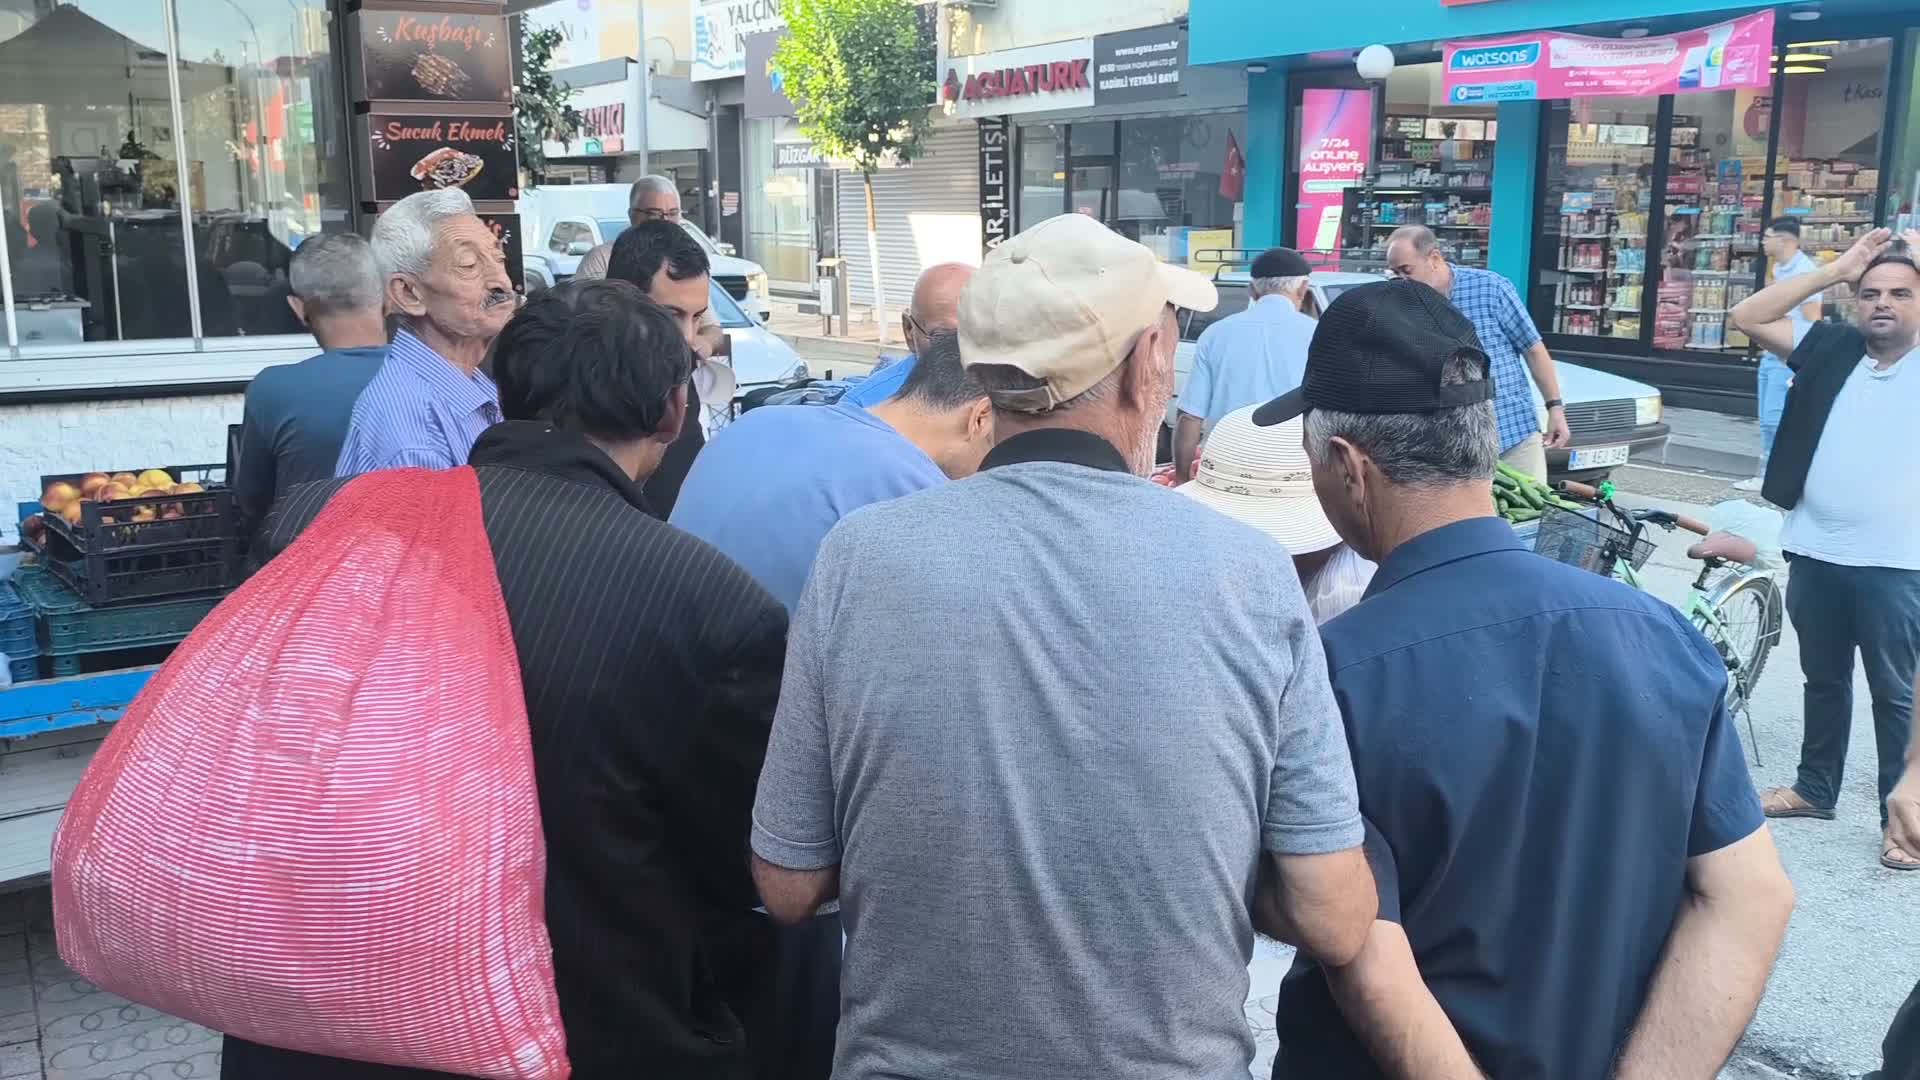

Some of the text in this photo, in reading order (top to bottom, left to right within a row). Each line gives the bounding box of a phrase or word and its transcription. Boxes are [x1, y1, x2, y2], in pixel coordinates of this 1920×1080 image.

[394, 16, 482, 50] Kuşbaşı
[1462, 50, 1529, 66] watsons
[386, 121, 506, 143] Sucuk Ekmek
[1320, 138, 1350, 148] 7/24
